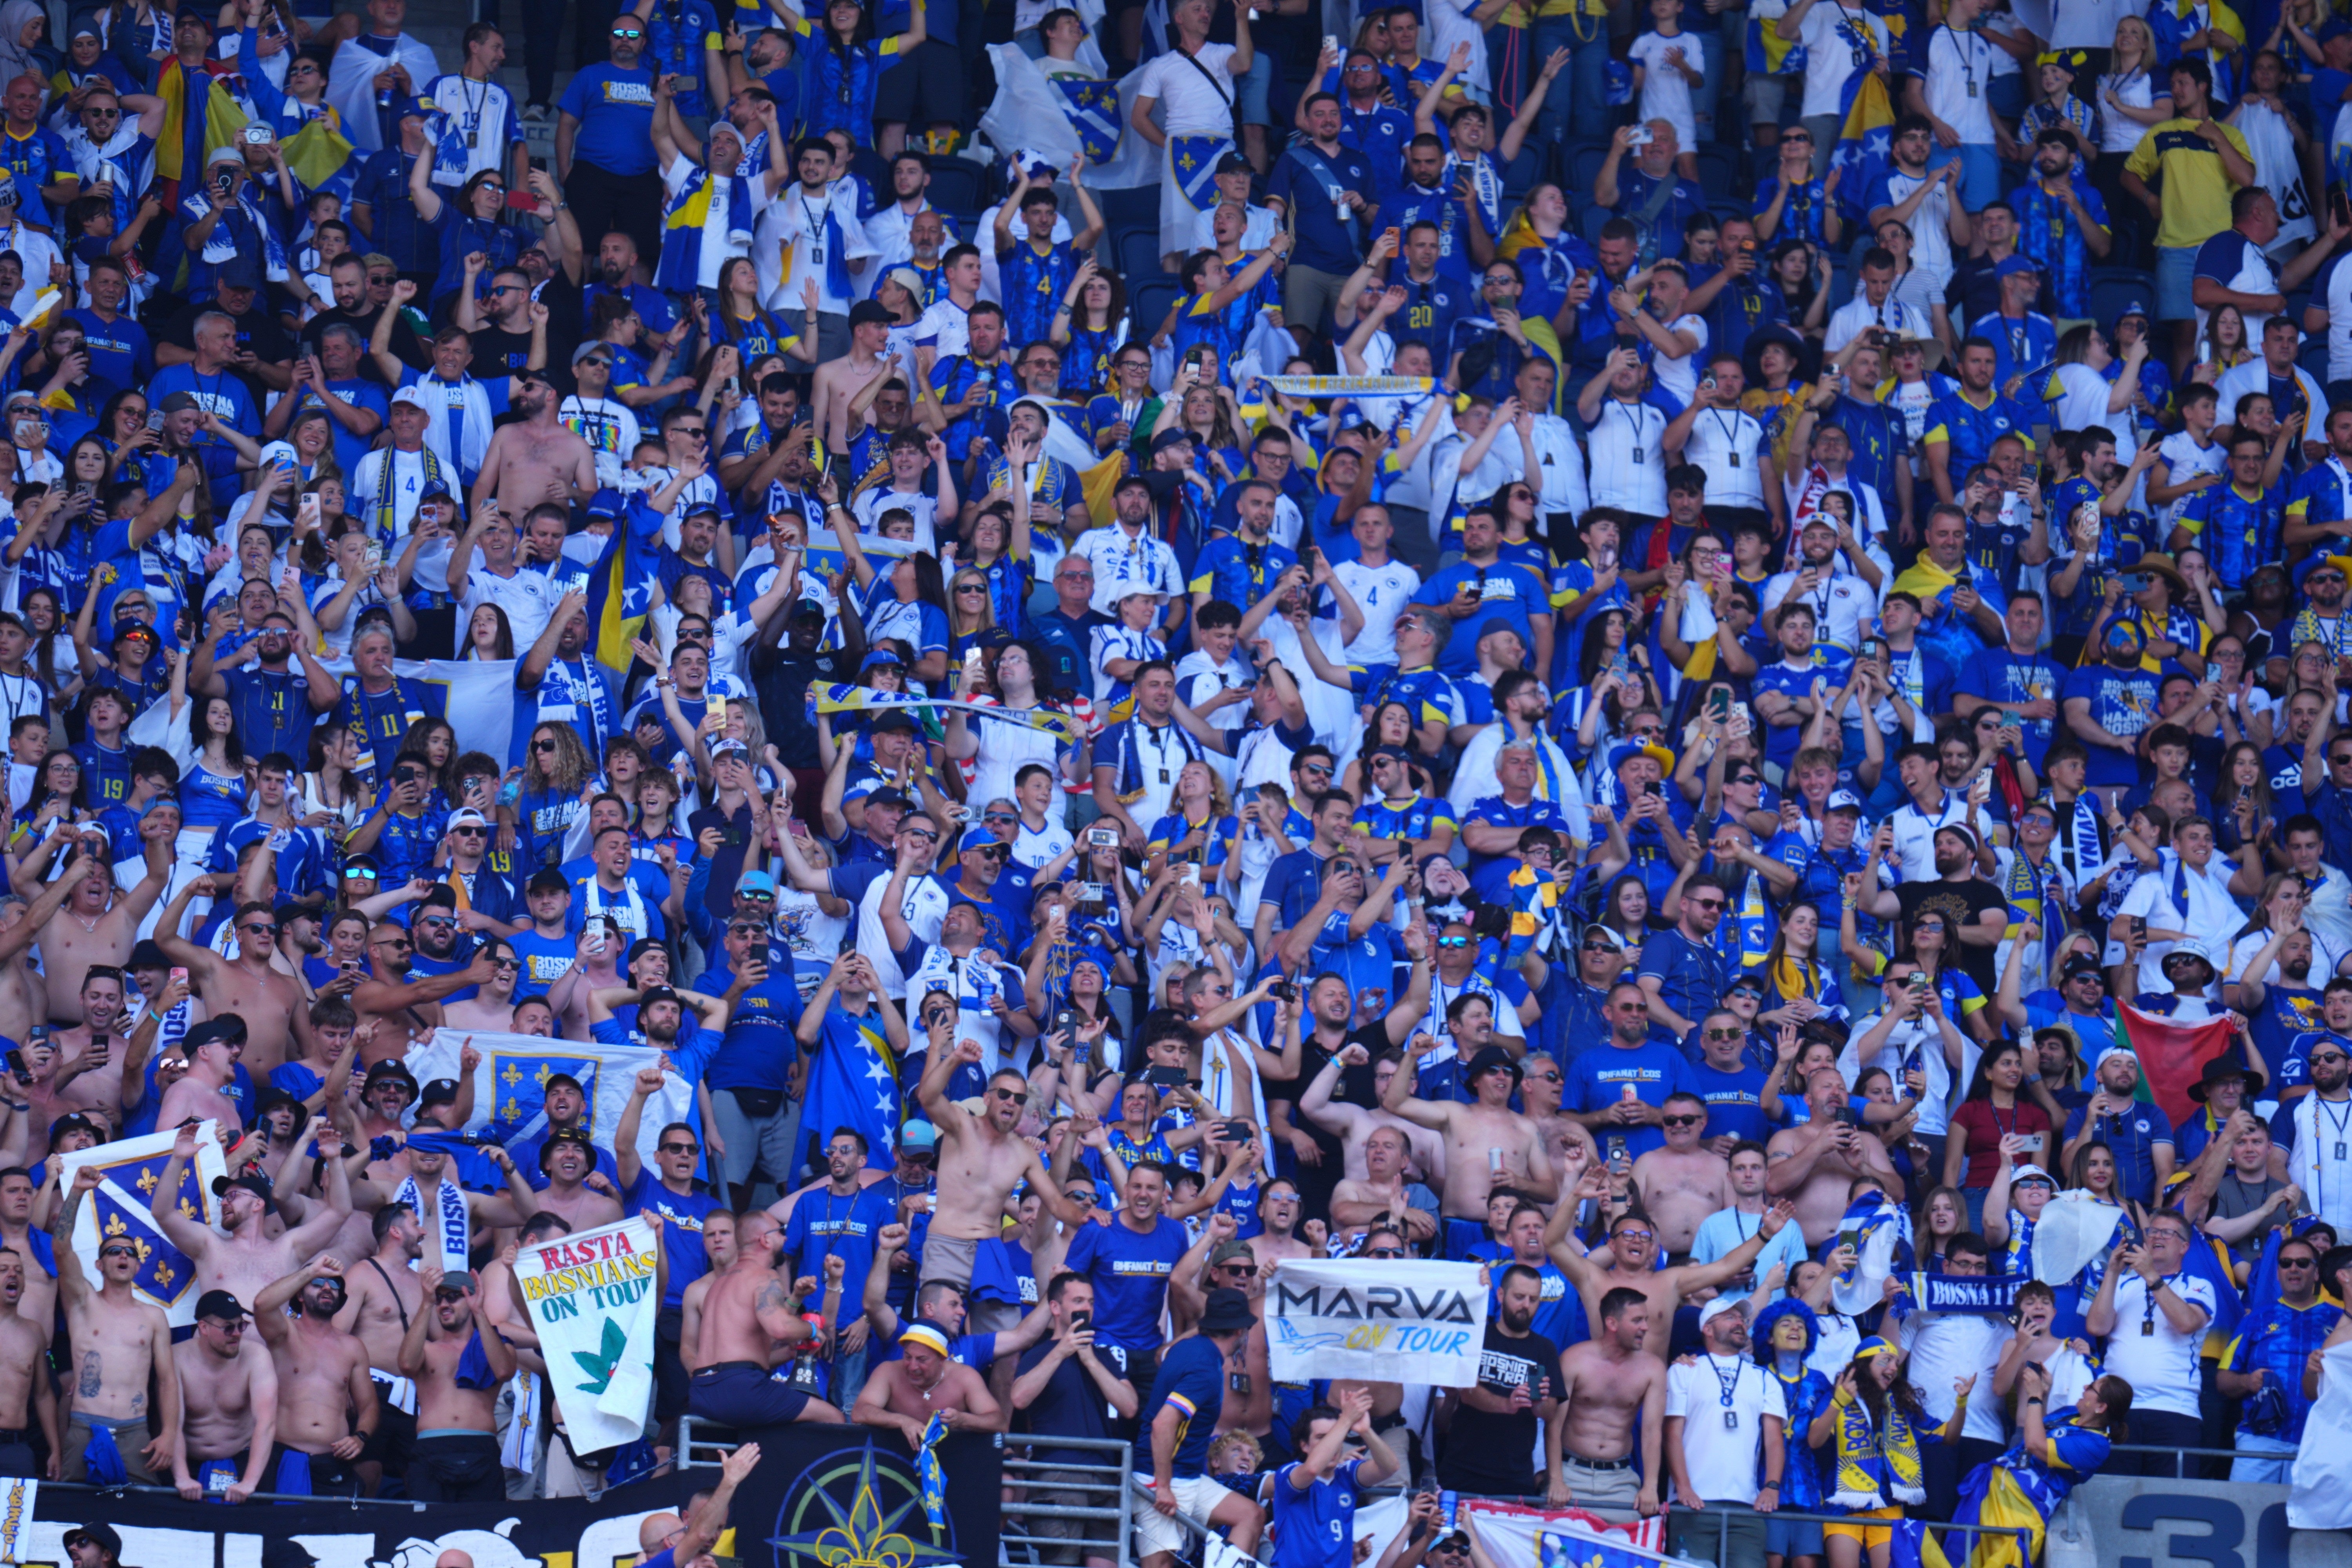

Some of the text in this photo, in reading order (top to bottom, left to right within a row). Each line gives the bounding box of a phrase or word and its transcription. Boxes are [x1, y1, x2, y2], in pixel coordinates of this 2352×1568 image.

[11, 160, 28, 175] 11
[1036, 275, 1051, 295] 4
[1410, 306, 1433, 329] 20
[749, 336, 768, 355] 20
[126, 463, 141, 481] 19
[405, 476, 416, 493] 4
[1980, 548, 1993, 568] 11
[1366, 584, 1377, 606] 4
[1465, 578, 1515, 592] BSNA
[381, 713, 399, 737] 11
[103, 777, 124, 799] 19
[200, 774, 242, 794] BOSNIA
[488, 851, 512, 873] 19
[539, 1232, 633, 1272] RASTA
[521, 1250, 657, 1301] BOSNIANS
[1277, 1282, 1475, 1325] MARVA
[1931, 1280, 1990, 1306] BOSNA
[541, 1294, 578, 1323] ON
[1345, 1324, 1471, 1357] ON TOUR
[1330, 1519, 1344, 1543] 9
